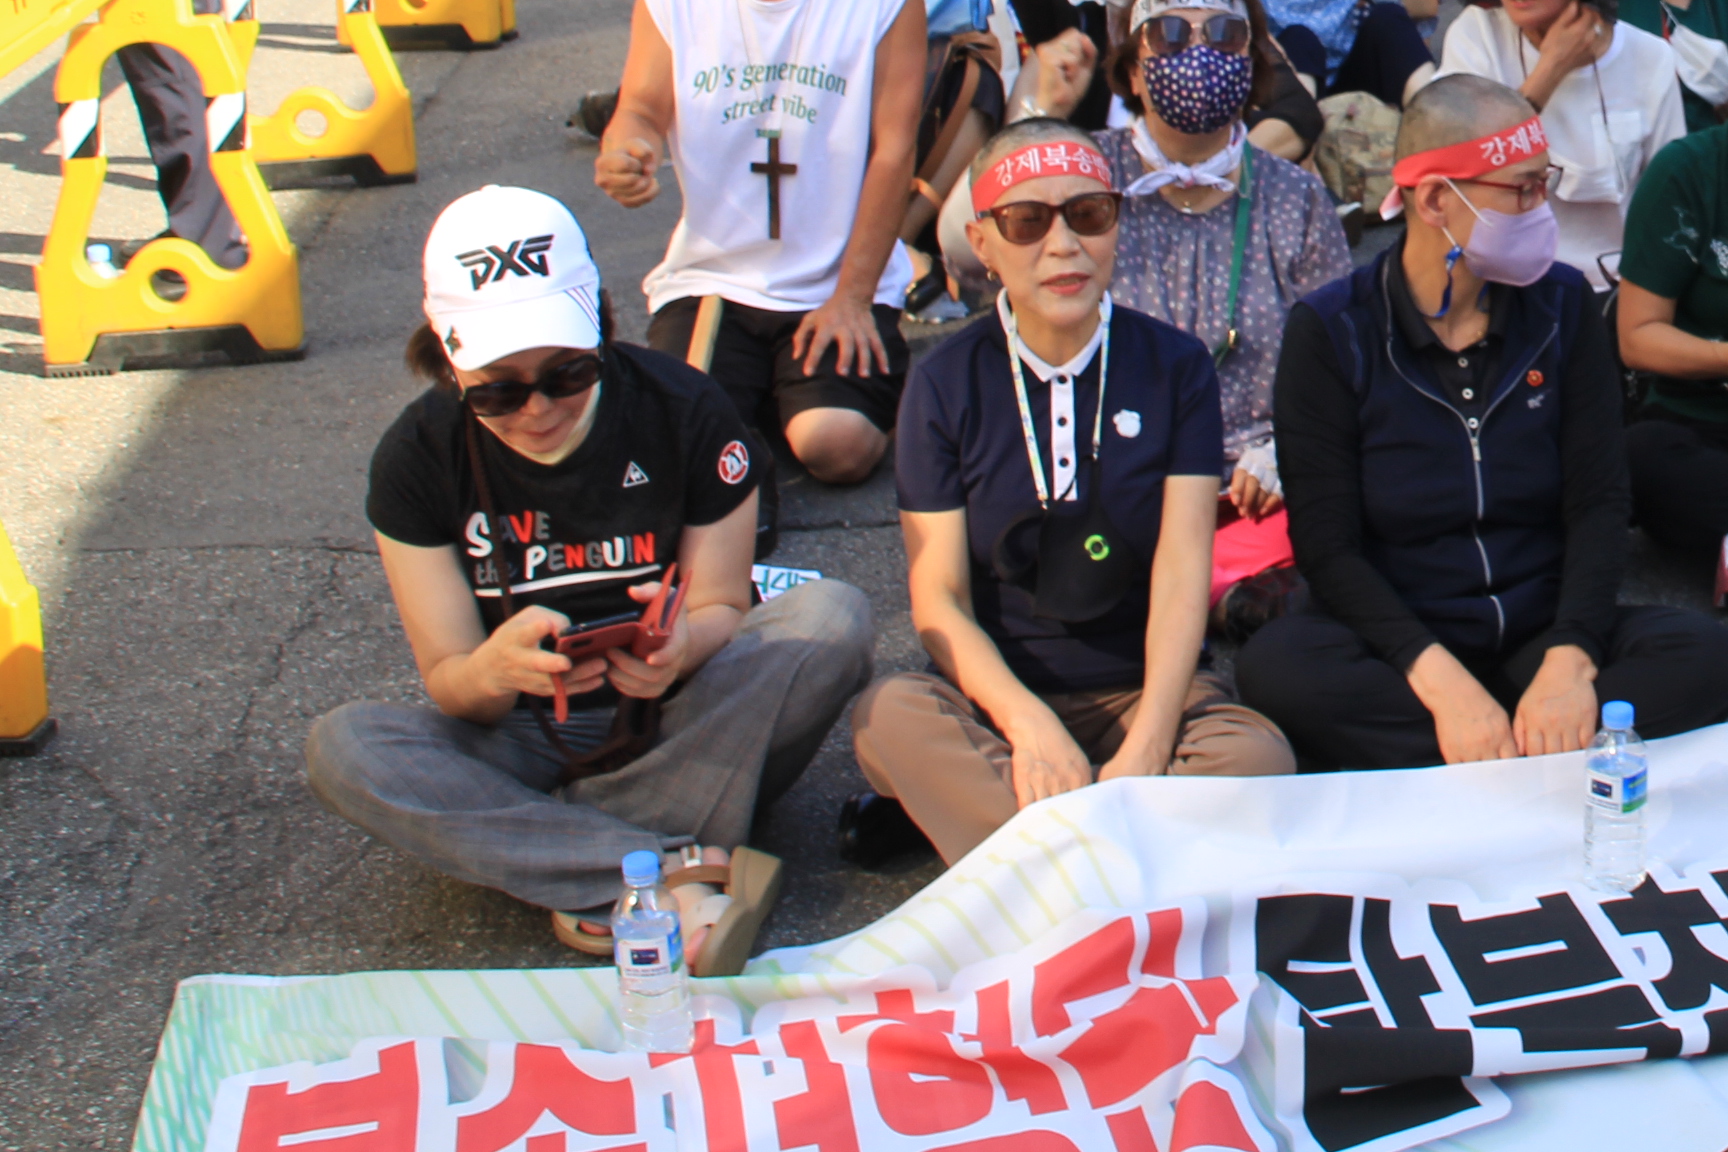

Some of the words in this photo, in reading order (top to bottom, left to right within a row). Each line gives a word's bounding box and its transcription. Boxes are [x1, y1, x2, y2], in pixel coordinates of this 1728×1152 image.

[739, 61, 848, 97] generation
[721, 95, 776, 126] street
[781, 95, 818, 125] vibe
[455, 233, 555, 292] PXG
[524, 532, 655, 581] PENGUIN
